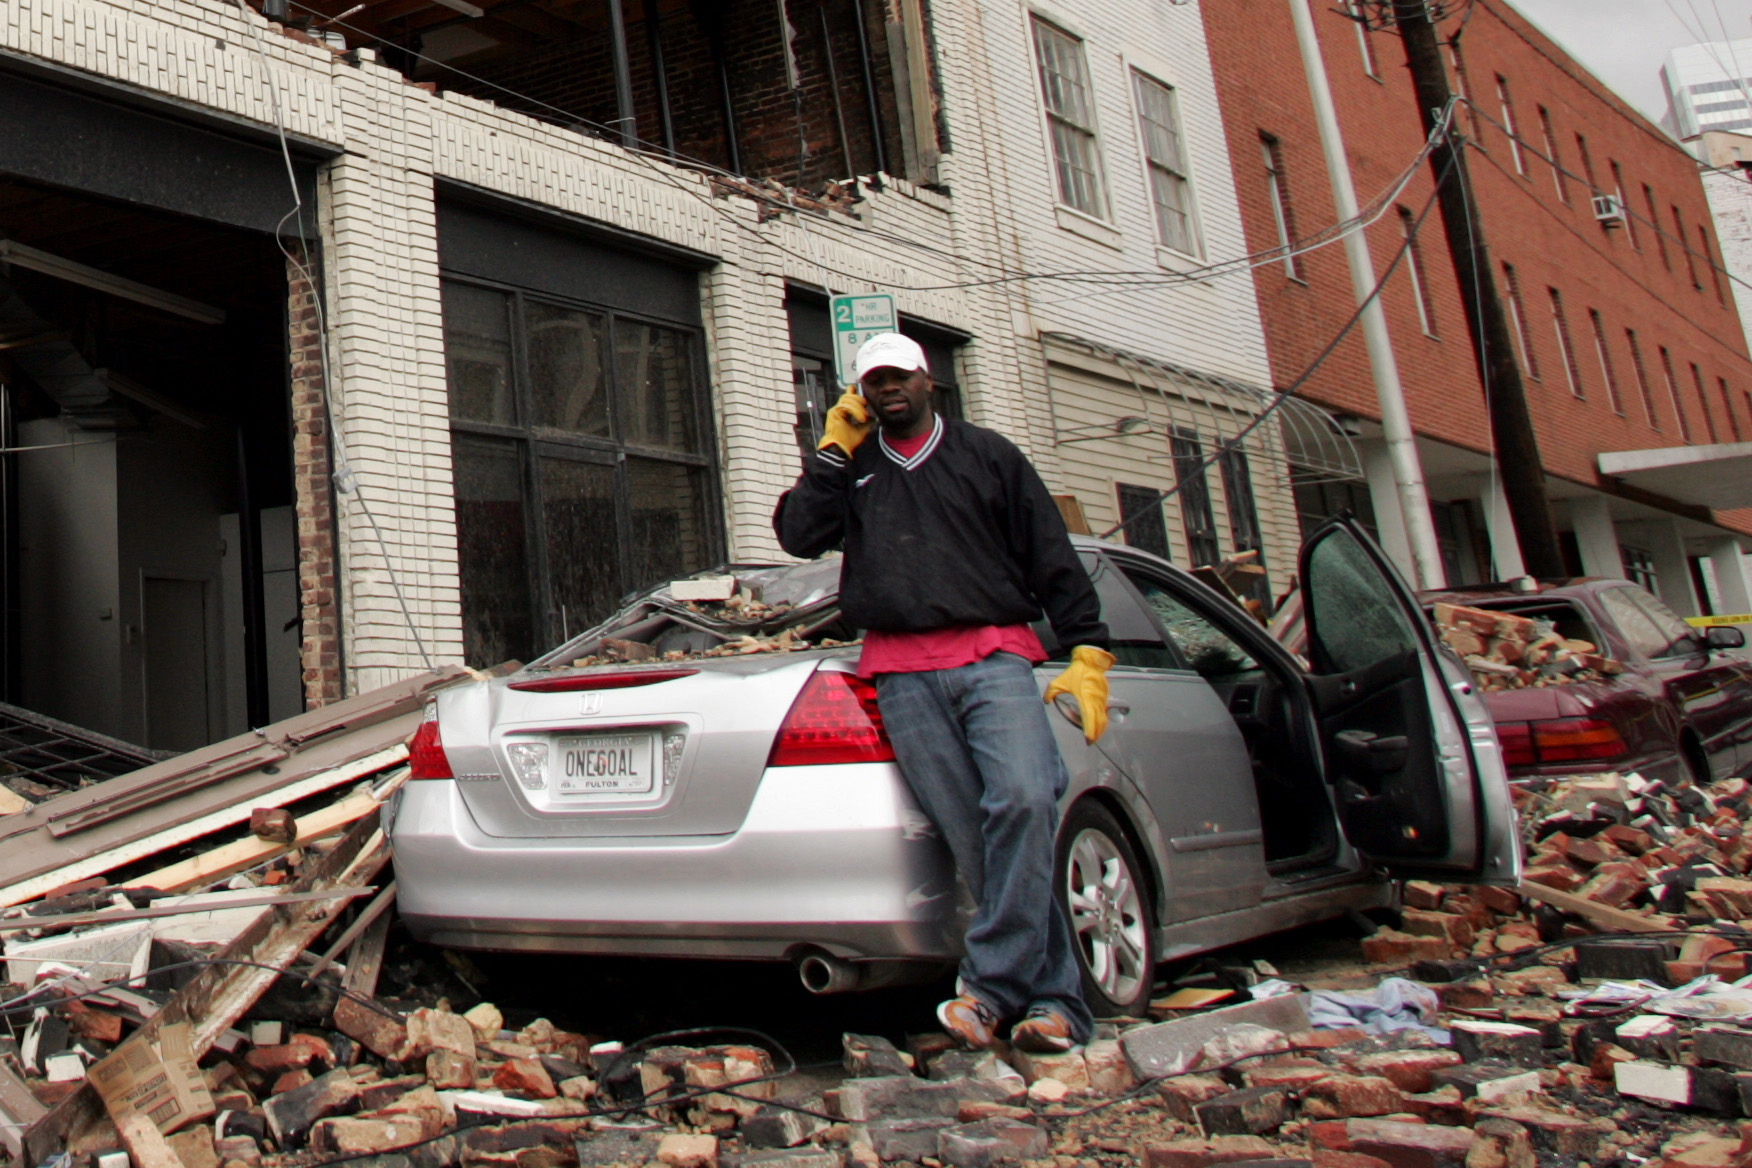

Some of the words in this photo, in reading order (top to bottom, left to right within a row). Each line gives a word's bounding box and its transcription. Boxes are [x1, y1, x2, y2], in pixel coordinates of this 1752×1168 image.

[865, 302, 877, 311] HR
[836, 305, 851, 323] 2
[855, 313, 890, 323] PARKING
[848, 333, 857, 344] 8
[577, 737, 632, 747] GEORGIA
[565, 749, 638, 777] ONEGOAL
[585, 780, 619, 788] FULTON
